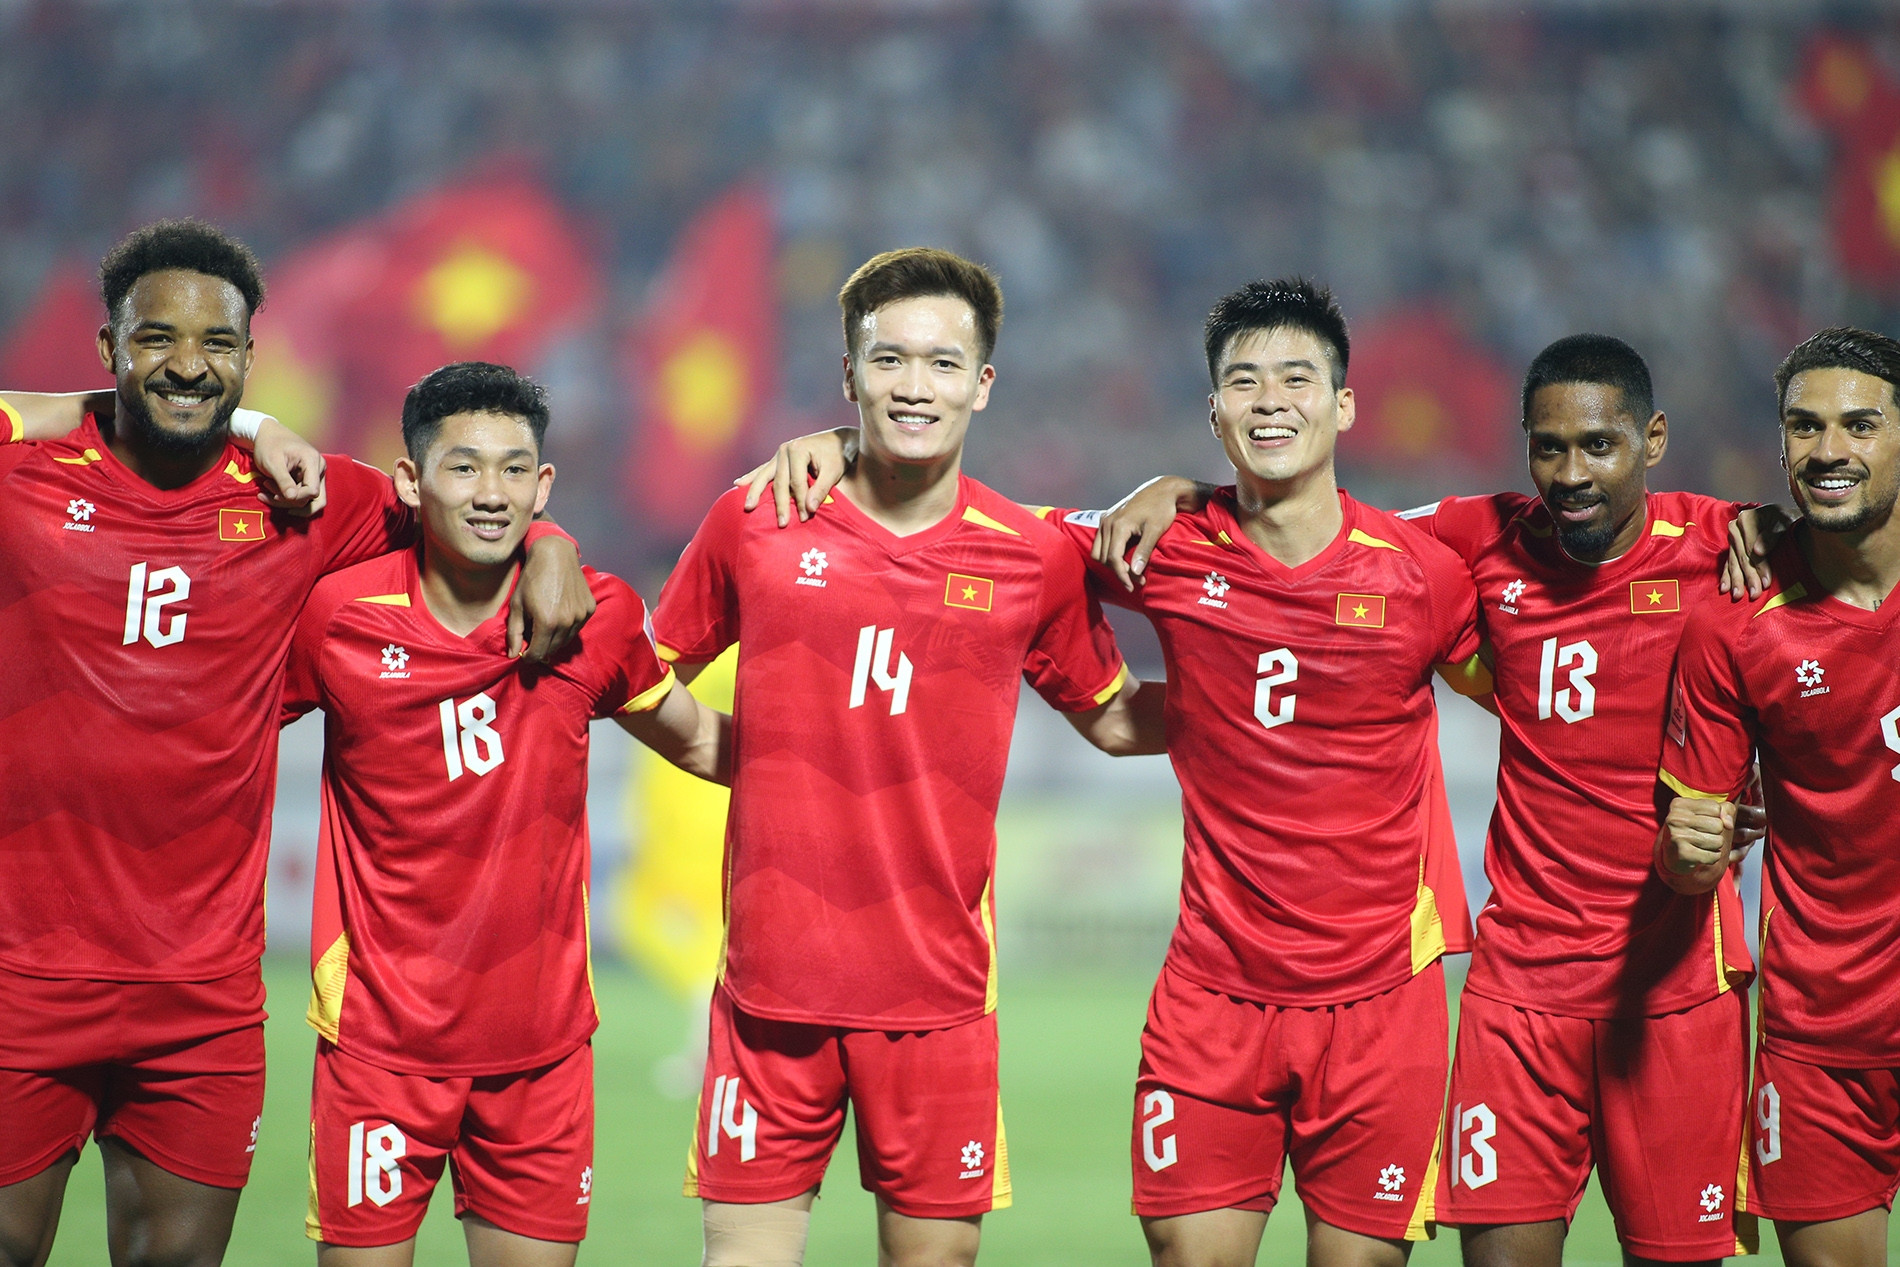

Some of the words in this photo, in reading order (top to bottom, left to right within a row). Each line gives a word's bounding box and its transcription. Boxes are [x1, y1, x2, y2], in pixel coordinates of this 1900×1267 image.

[123, 562, 191, 648] 12
[849, 625, 913, 716] 14
[1253, 648, 1298, 729] 2
[1538, 637, 1598, 724] 13
[1800, 686, 1830, 698] JOGARBOLA
[439, 692, 504, 782] 18
[707, 1075, 757, 1162] 14
[1143, 1091, 1177, 1172] 2
[1450, 1103, 1497, 1190] 13
[1756, 1083, 1781, 1165] 9
[348, 1121, 406, 1207] 18
